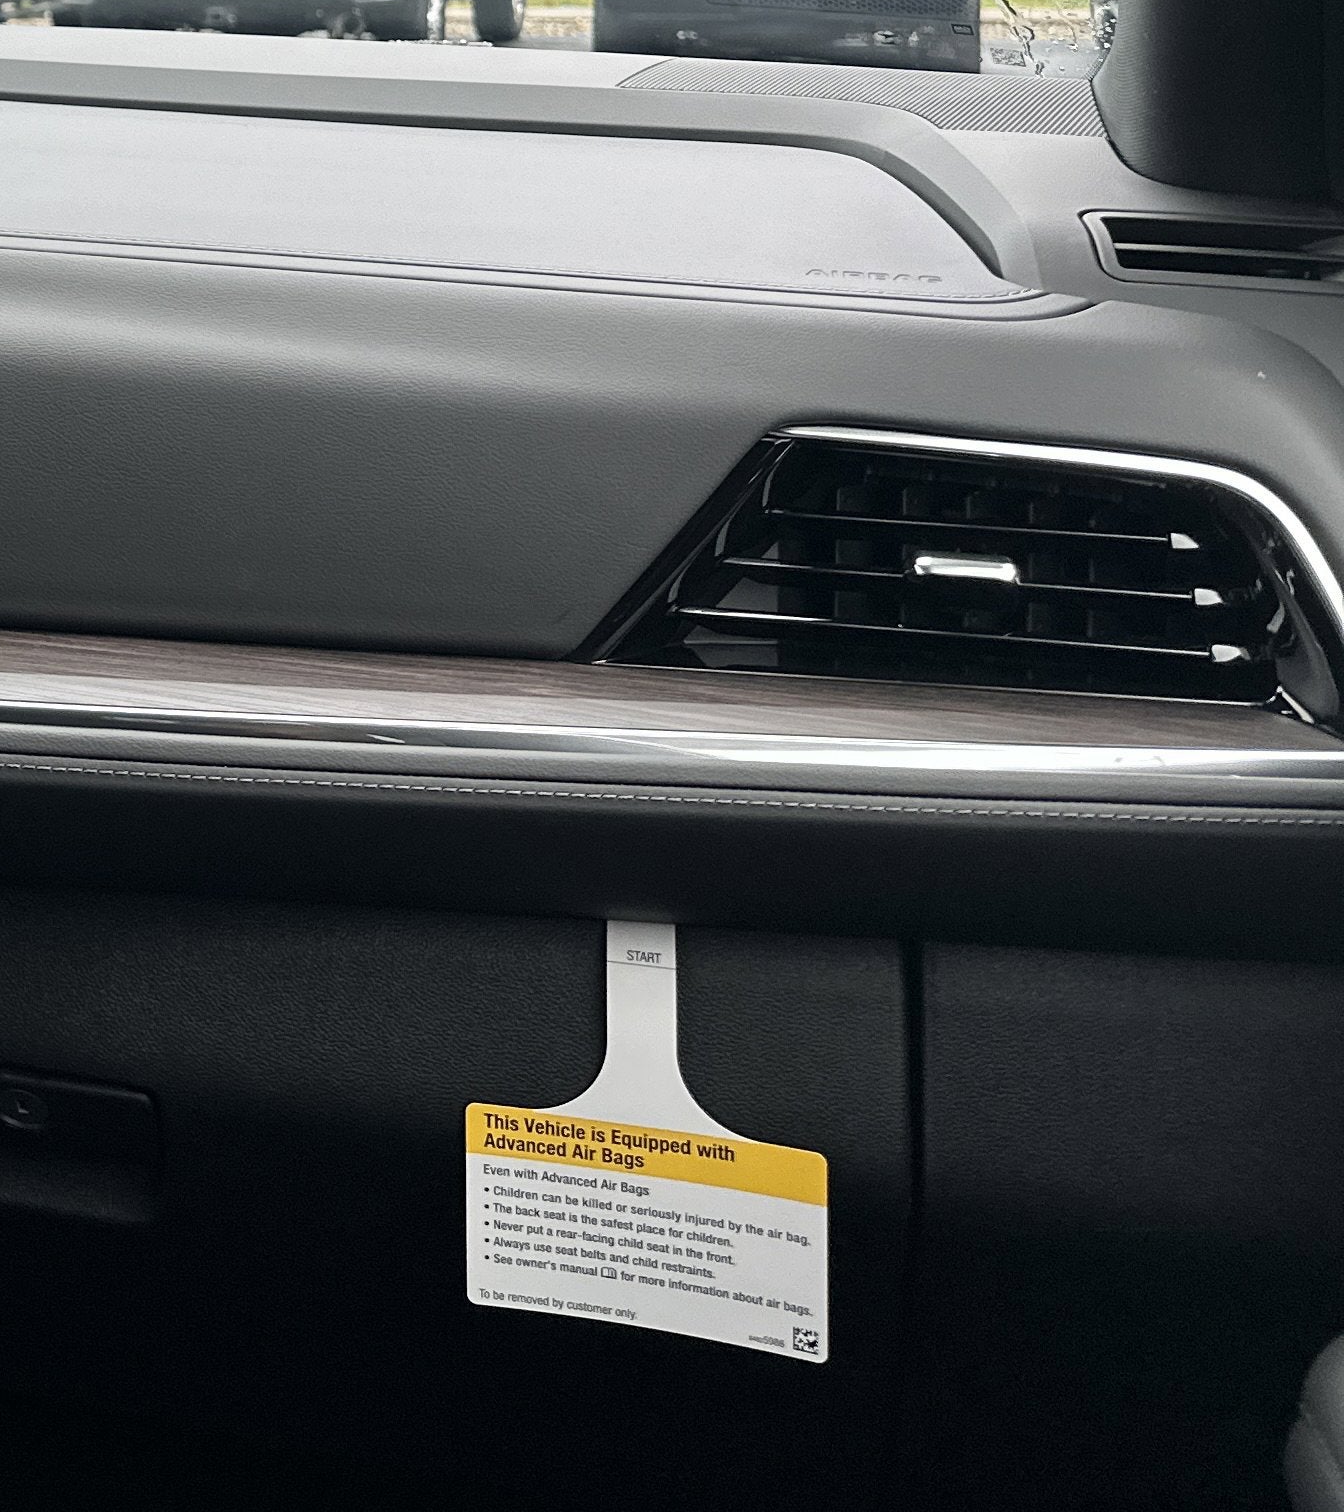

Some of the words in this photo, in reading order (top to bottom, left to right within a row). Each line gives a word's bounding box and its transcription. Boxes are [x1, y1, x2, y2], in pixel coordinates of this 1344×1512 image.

[626, 949, 662, 965] START
[483, 1112, 518, 1131] This
[523, 1117, 585, 1139] Vehicle
[590, 1125, 605, 1142] is
[611, 1128, 691, 1155] Equipped
[696, 1143, 734, 1162] with
[483, 1132, 566, 1157] Advanced
[571, 1143, 596, 1161] Air
[601, 1147, 644, 1169] Bags
[483, 1163, 510, 1176] Even
[513, 1168, 537, 1180] with
[540, 1170, 597, 1188] Advanced
[600, 1178, 617, 1190] Air
[620, 1181, 649, 1196] Bags
[492, 1202, 512, 1214] The
[515, 1204, 540, 1217] back
[543, 1210, 565, 1221] seat
[568, 1212, 577, 1222] is
[580, 1213, 597, 1225] the
[600, 1218, 633, 1231] safest
[636, 1223, 665, 1236] place
[668, 1227, 683, 1238] for
[686, 1230, 732, 1247] children.
[493, 1185, 538, 1200] Children
[541, 1193, 561, 1203] can
[564, 1194, 578, 1206] be
[581, 1196, 612, 1210] killed
[615, 1203, 627, 1212] or
[630, 1205, 681, 1223] seriously
[684, 1213, 724, 1228] injured
[727, 1220, 742, 1233] by
[744, 1224, 764, 1235] the
[766, 1229, 782, 1239] air
[785, 1231, 810, 1246] bag.
[493, 1219, 524, 1232] Never
[526, 1225, 543, 1235] put
[546, 1227, 553, 1236] a
[555, 1229, 614, 1247] rear-facing
[617, 1237, 643, 1249] child
[646, 1242, 669, 1253] seat
[672, 1244, 682, 1256] in
[685, 1247, 703, 1259] the
[706, 1250, 735, 1265] front.
[493, 1236, 530, 1250] Always
[533, 1243, 551, 1253] use
[555, 1245, 577, 1256] seat
[580, 1247, 606, 1260] belts
[609, 1253, 629, 1264] and
[631, 1256, 658, 1269] child
[661, 1262, 714, 1278] restraints.
[479, 1287, 490, 1299] To
[492, 1289, 504, 1300] be
[507, 1293, 549, 1306] removed
[551, 1297, 564, 1310] by
[566, 1301, 612, 1315] customer
[614, 1308, 635, 1320] only.
[493, 1253, 512, 1264] See
[515, 1257, 556, 1270] owner's
[559, 1263, 597, 1276] manual
[620, 1270, 634, 1281] for
[638, 1275, 665, 1287] more
[668, 1277, 729, 1298] information
[732, 1291, 762, 1306] about
[766, 1298, 780, 1308] air
[783, 1300, 809, 1316] bags.
